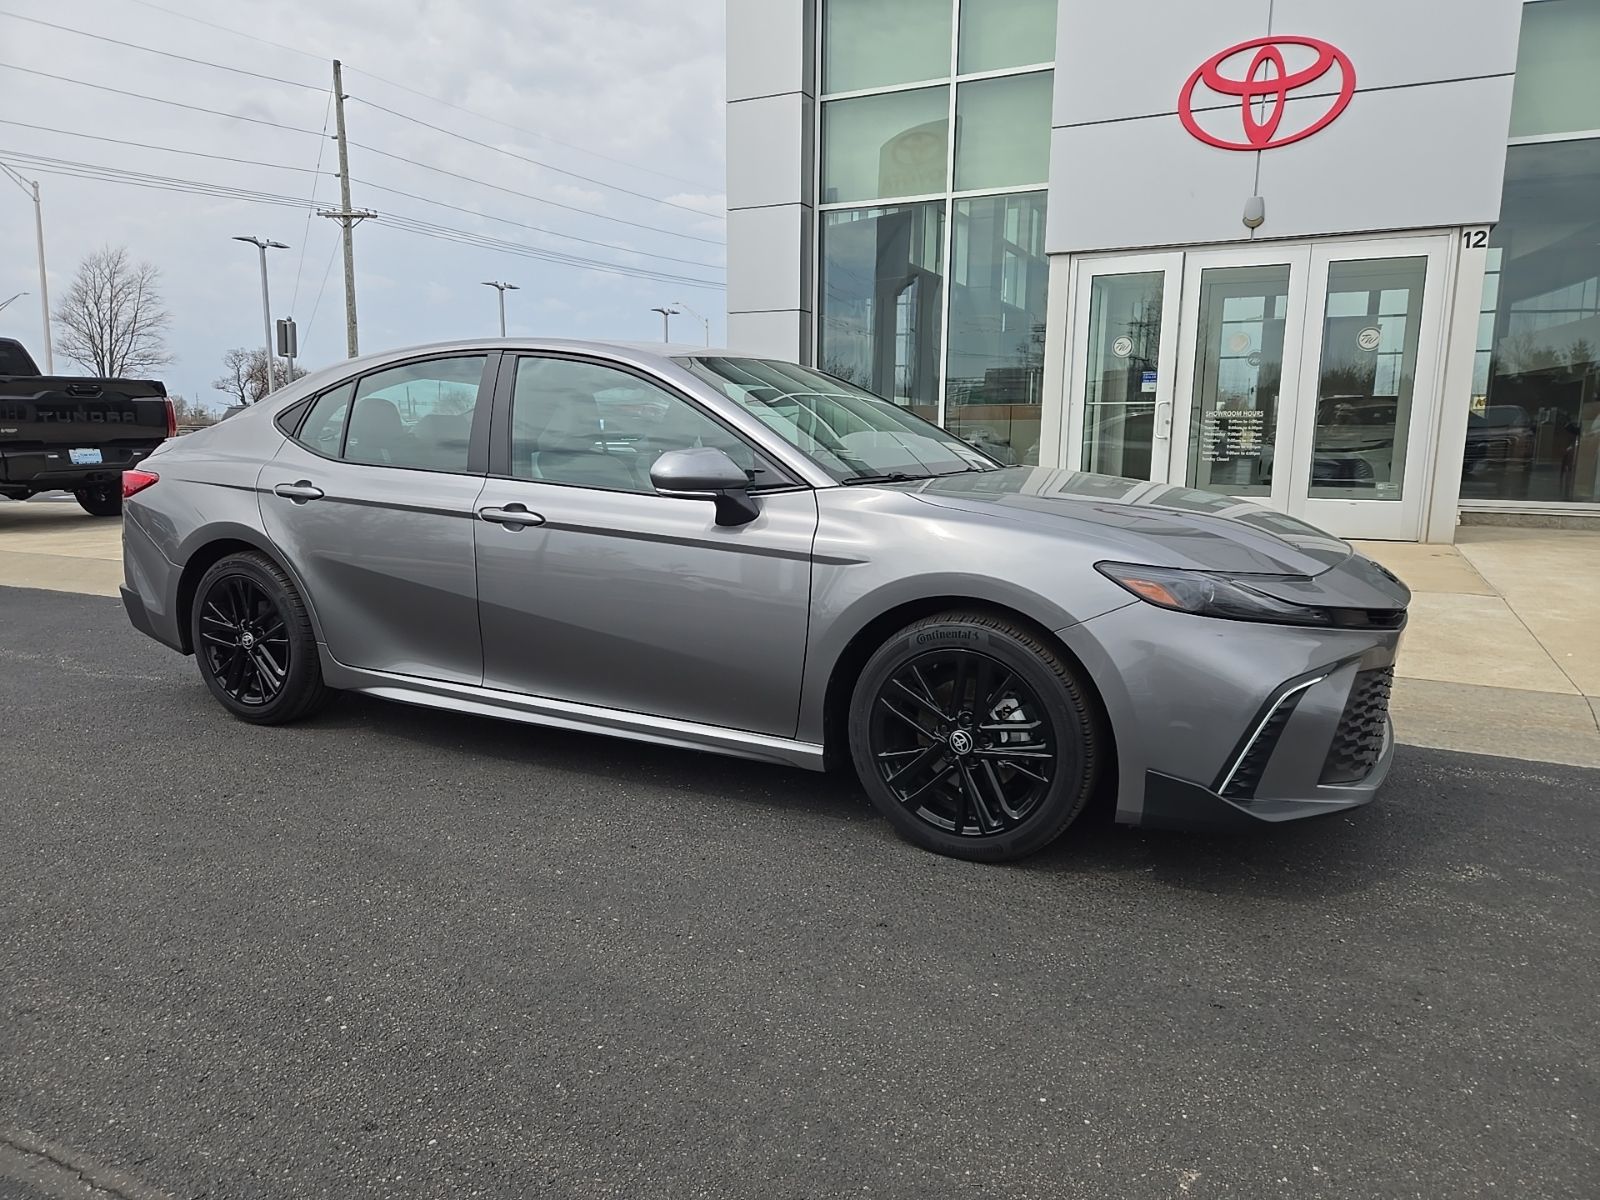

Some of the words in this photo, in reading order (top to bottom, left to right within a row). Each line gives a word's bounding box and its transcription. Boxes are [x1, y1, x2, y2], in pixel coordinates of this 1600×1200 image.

[1463, 230, 1487, 248] 12
[38, 411, 136, 422] TUNDRA
[1205, 410, 1242, 418] SHOWROOM
[916, 630, 972, 645] Continental
